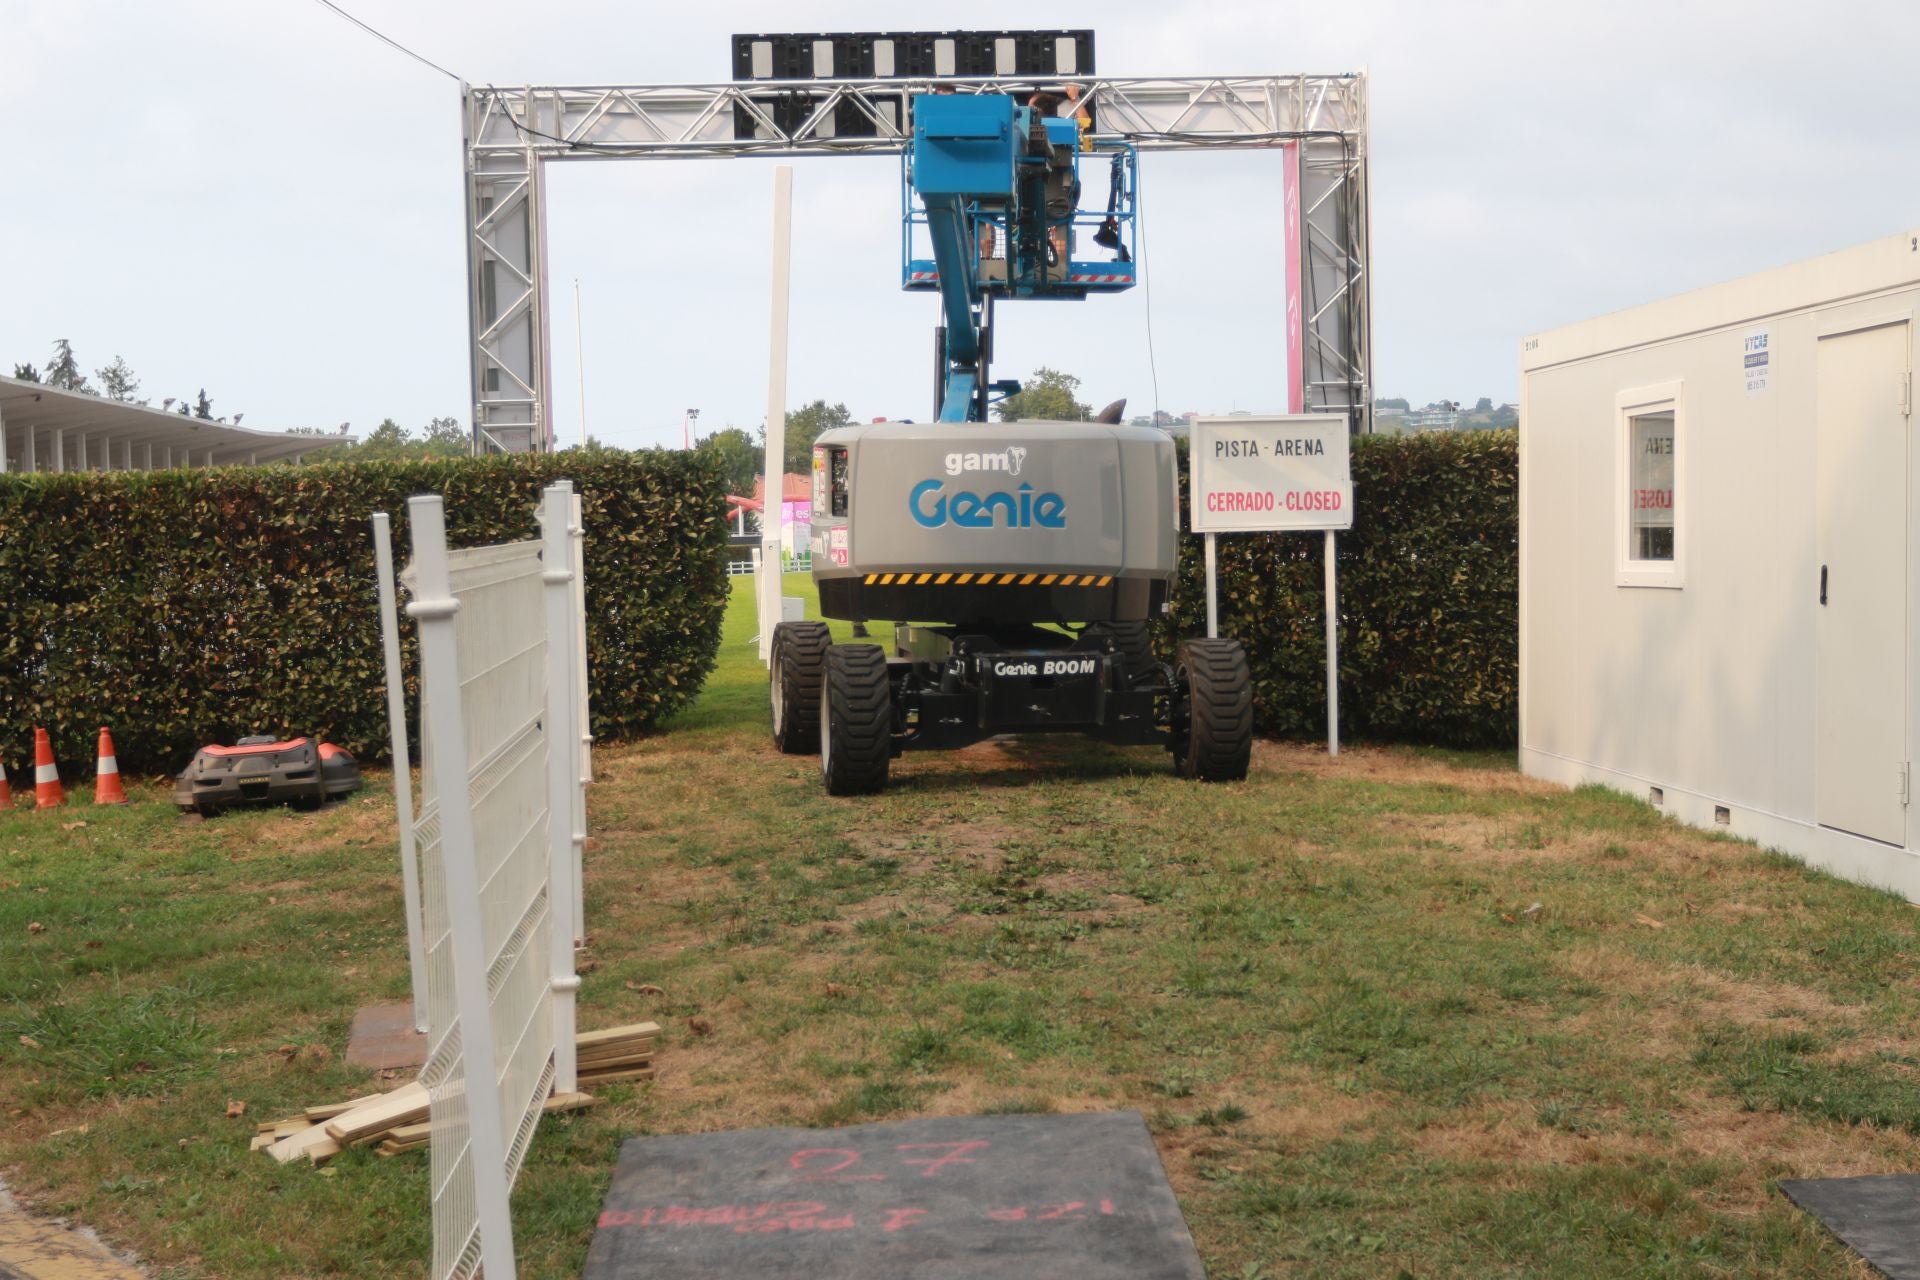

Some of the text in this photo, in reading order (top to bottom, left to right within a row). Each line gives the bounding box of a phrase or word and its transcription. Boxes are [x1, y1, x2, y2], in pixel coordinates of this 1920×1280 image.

[1215, 439, 1259, 457] PISTA
[1275, 438, 1324, 456] ARENA
[945, 452, 1008, 476] gam
[909, 479, 1067, 529] Genie
[1207, 491, 1275, 512] CERRADO
[1285, 490, 1342, 511] CLOSED
[995, 659, 1096, 676] Genie BOOM
